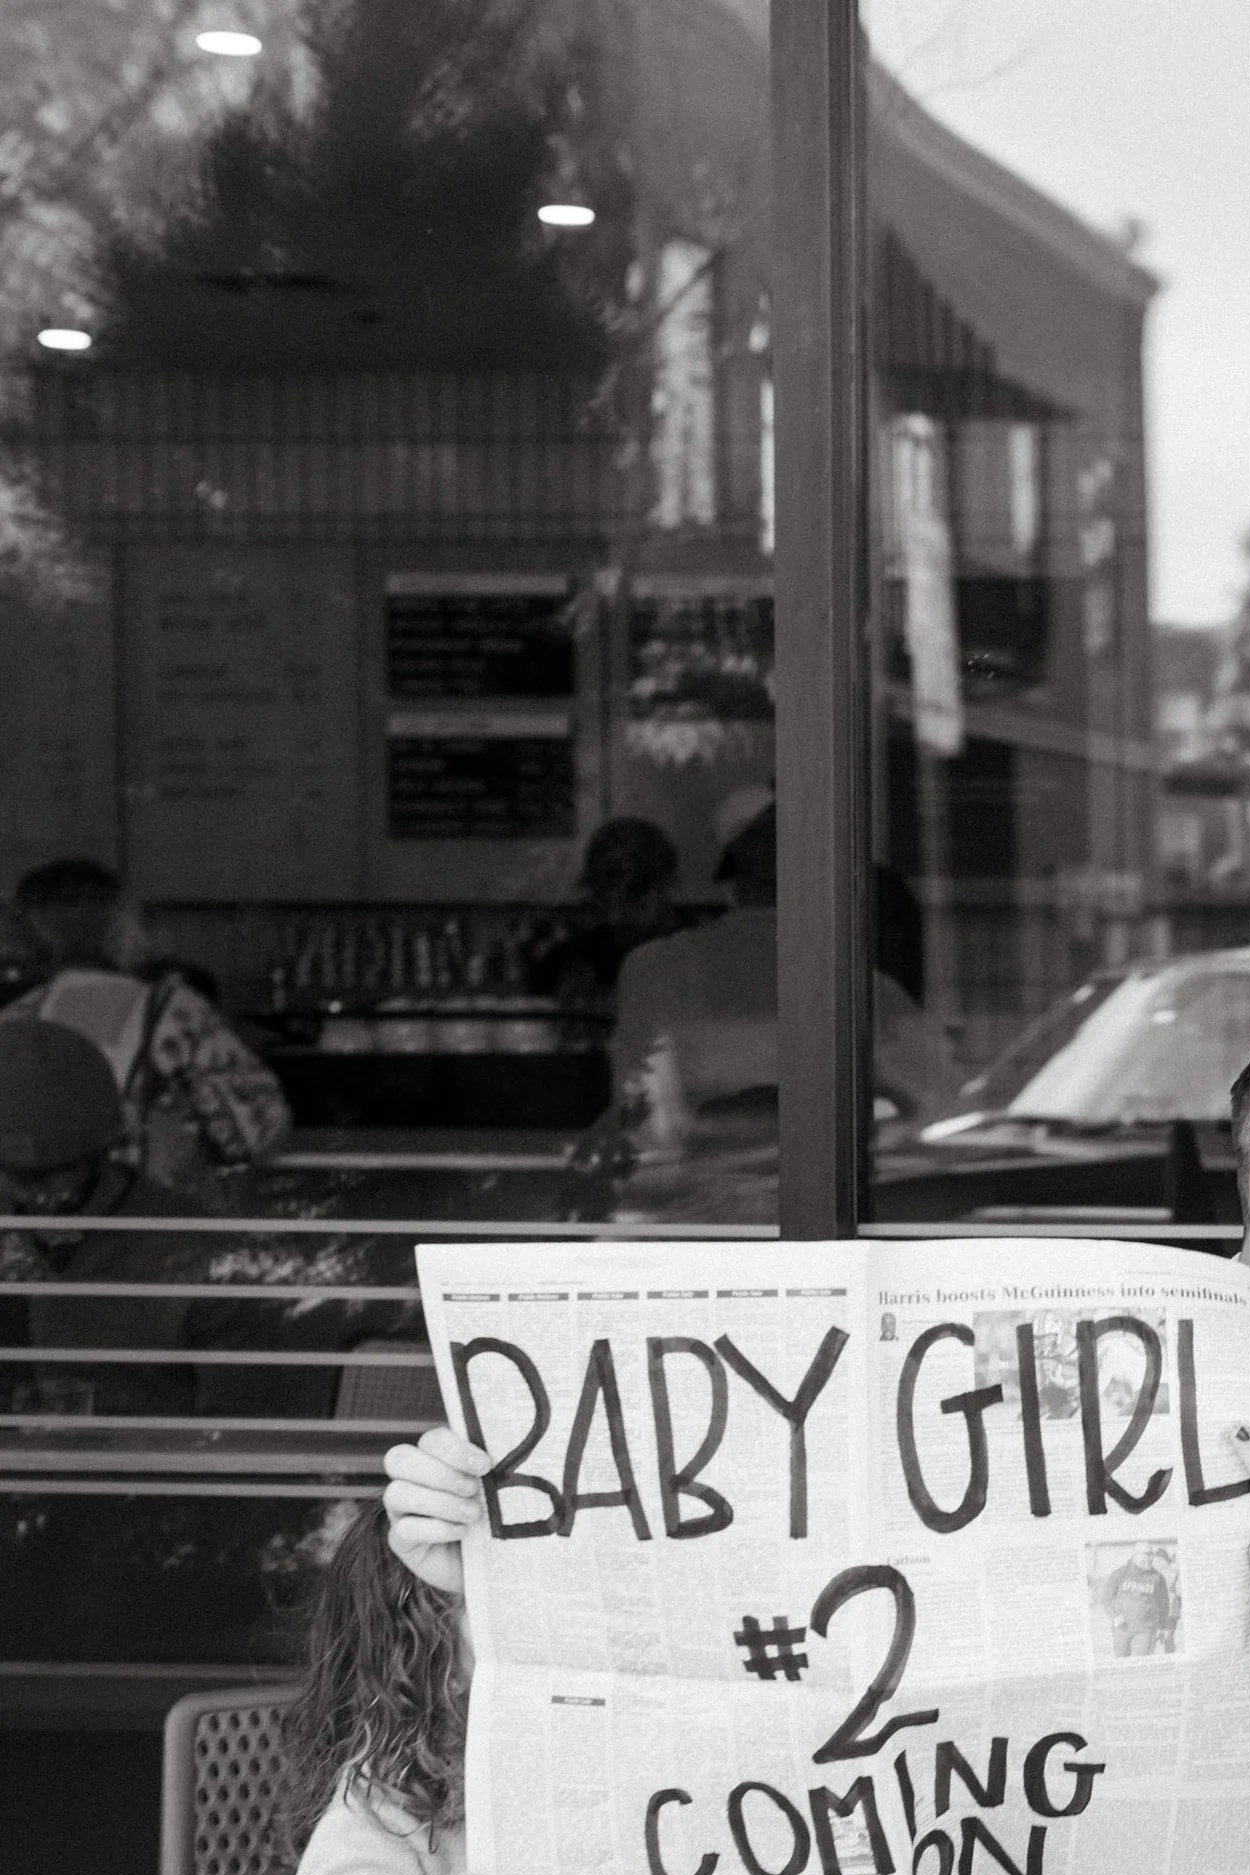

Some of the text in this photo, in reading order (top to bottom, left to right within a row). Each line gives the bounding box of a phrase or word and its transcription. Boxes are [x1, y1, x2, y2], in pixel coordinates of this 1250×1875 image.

[878, 1283, 1248, 1306] Harris boosts McGuinness into semifinals
[449, 1325, 851, 1541] BABY
[733, 1565, 940, 1765] #2
